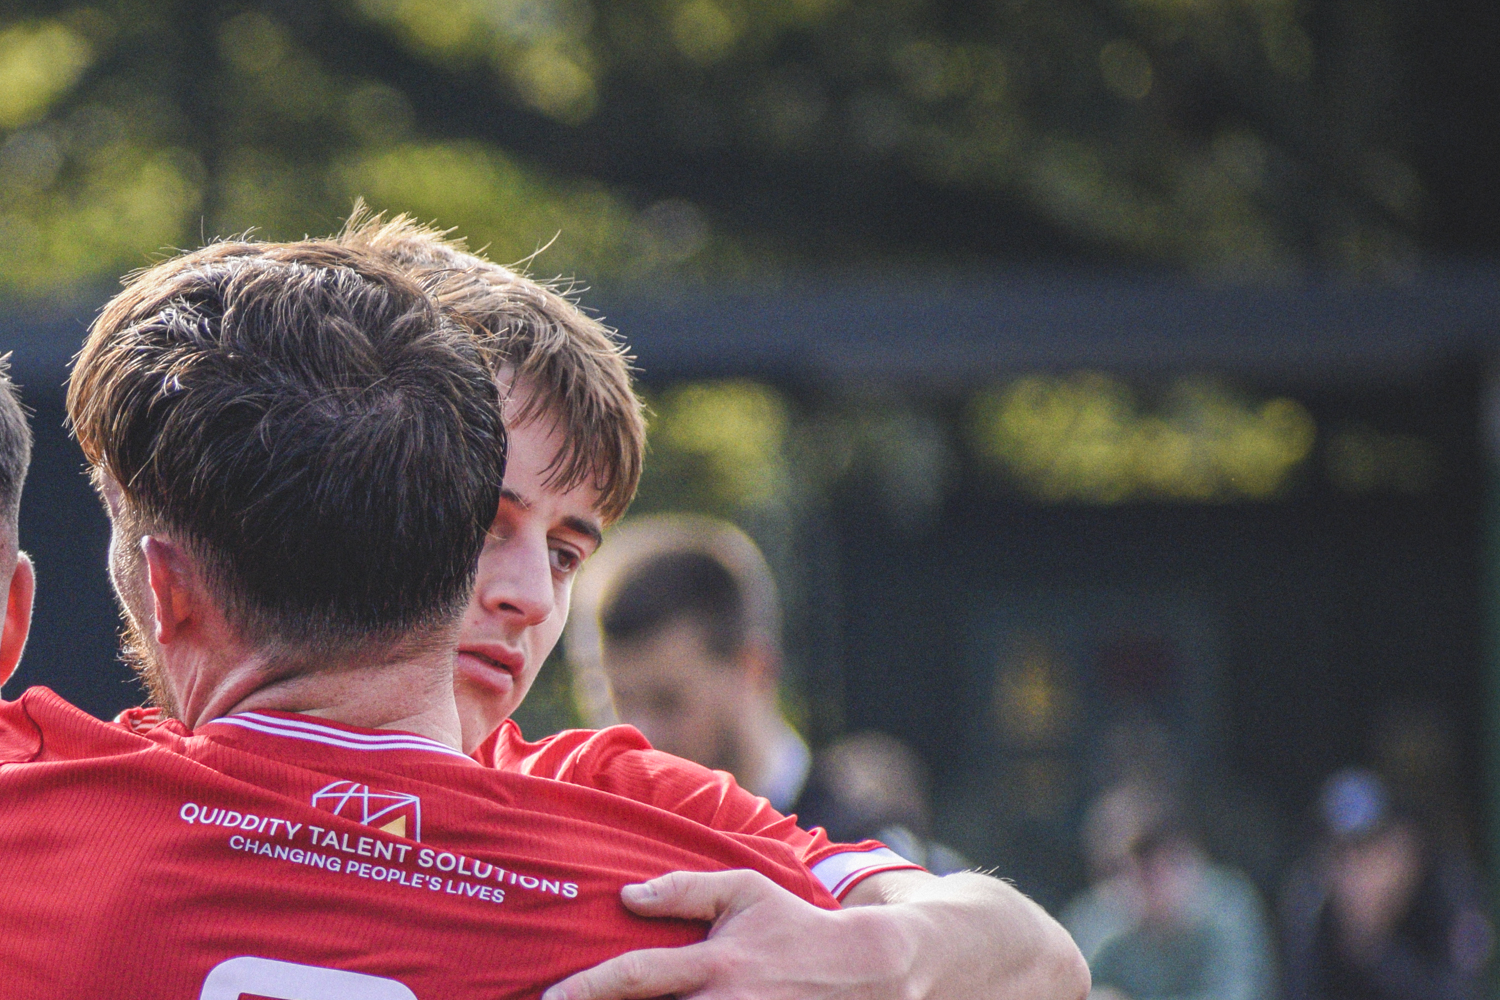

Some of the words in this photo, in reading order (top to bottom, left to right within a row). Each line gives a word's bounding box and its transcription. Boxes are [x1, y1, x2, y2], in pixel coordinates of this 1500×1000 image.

[180, 802, 302, 840] QUIDDITY
[309, 825, 412, 863] TALENT
[417, 848, 579, 899] SOLUTIONS
[229, 834, 342, 872] CHANGING
[345, 860, 443, 891] PEOPLE'S
[446, 879, 506, 904] LIVES
